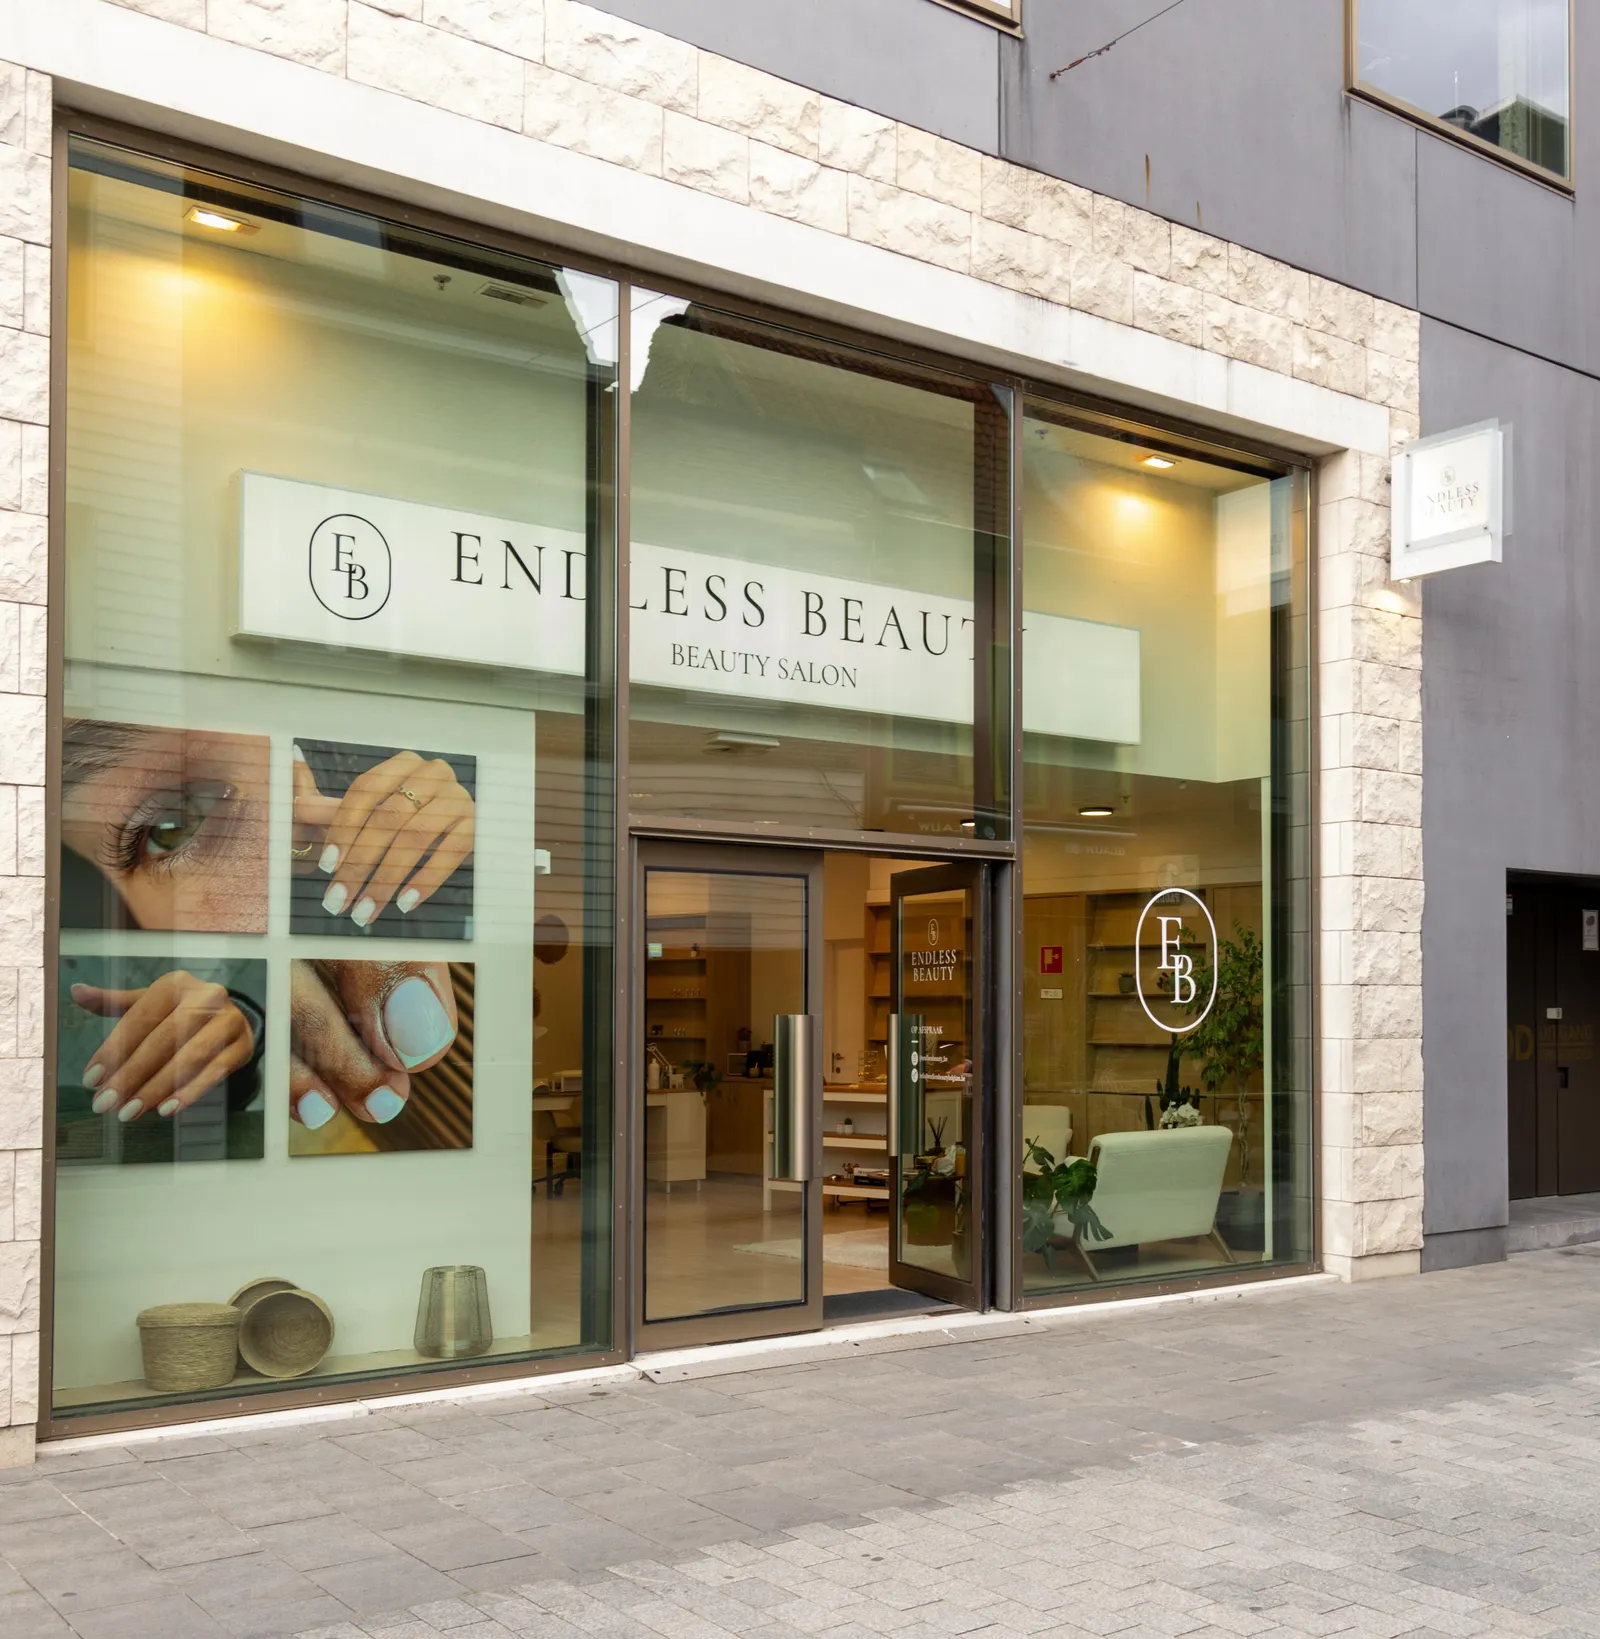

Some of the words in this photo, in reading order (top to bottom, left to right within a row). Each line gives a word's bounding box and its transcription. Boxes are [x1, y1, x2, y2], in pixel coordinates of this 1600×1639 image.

[800, 590, 1027, 661] BEAU
[671, 643, 771, 677] BEAUTY
[778, 658, 857, 689] SALON
[911, 949, 957, 965] ENDLESS
[913, 966, 954, 982] BEAUTY
[1156, 916, 1197, 1003] EB
